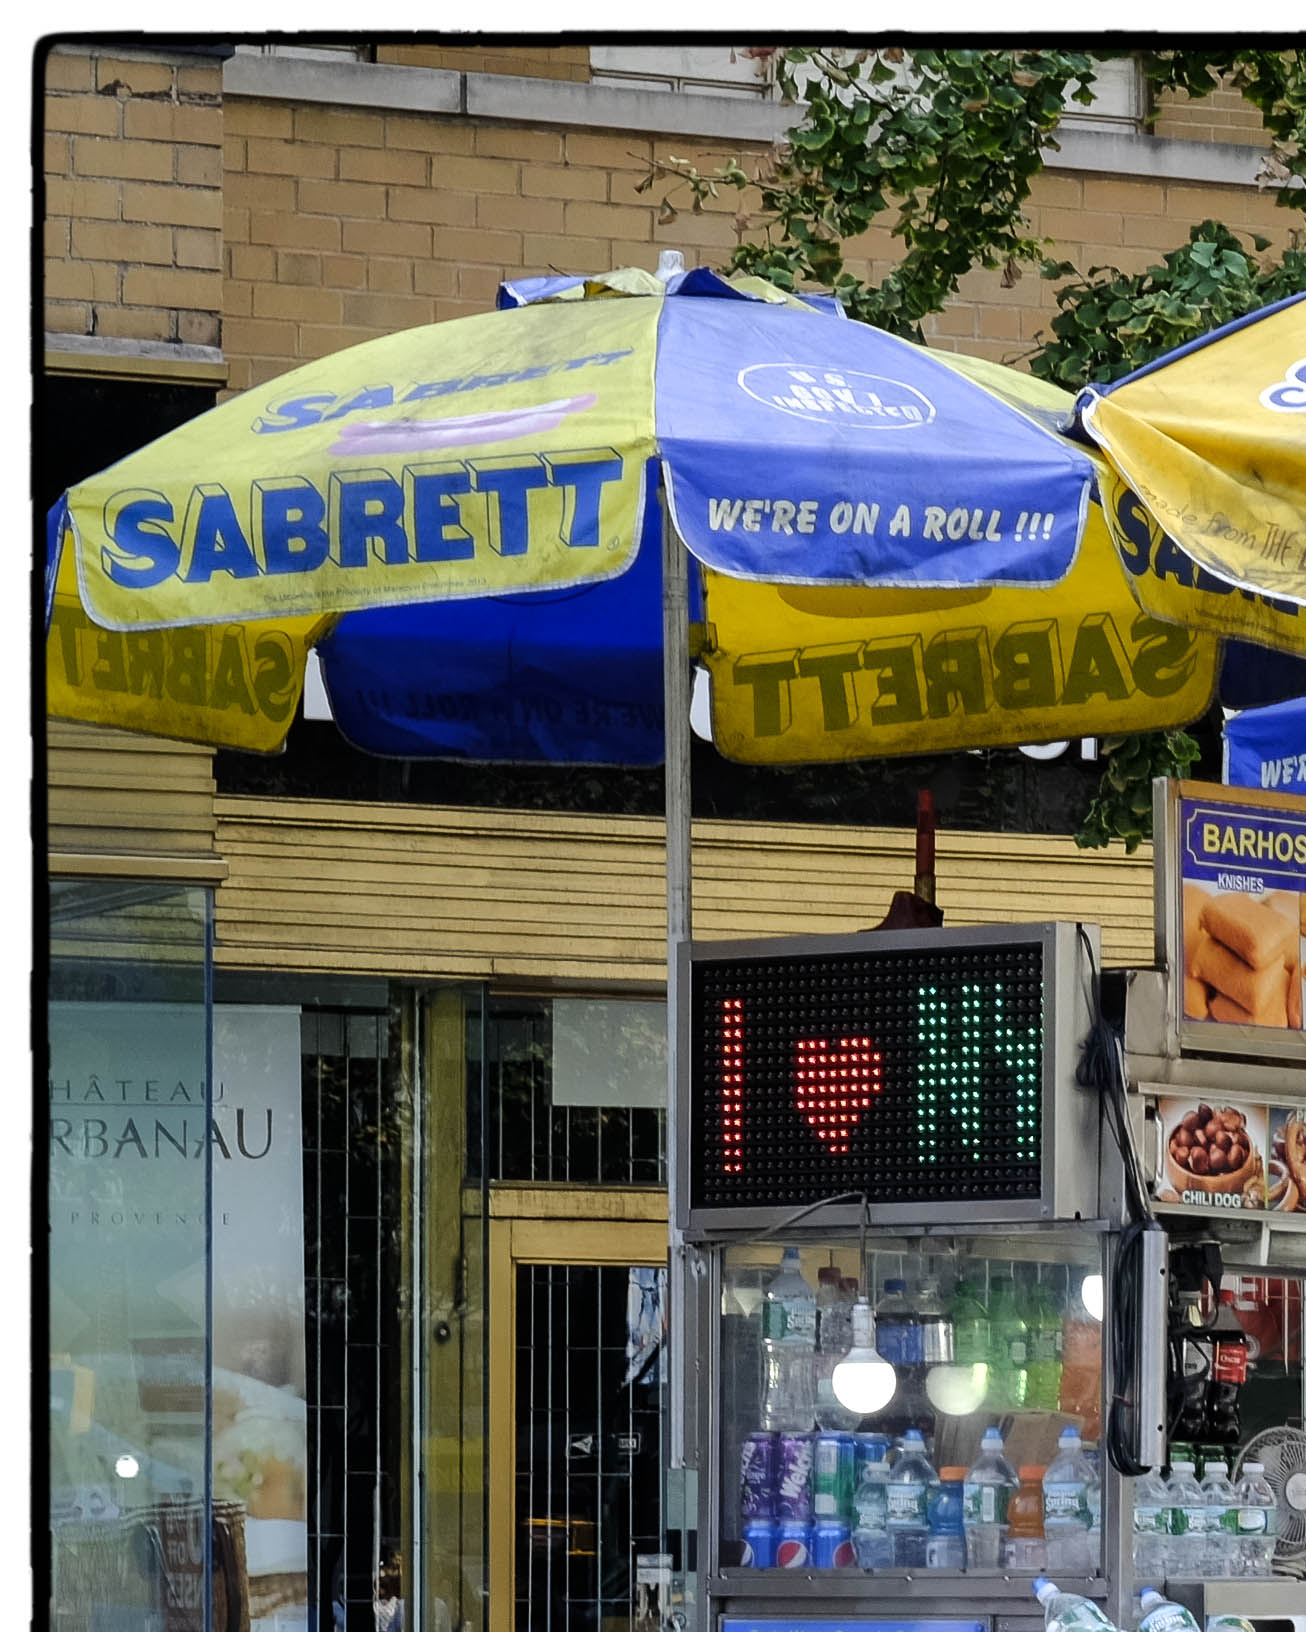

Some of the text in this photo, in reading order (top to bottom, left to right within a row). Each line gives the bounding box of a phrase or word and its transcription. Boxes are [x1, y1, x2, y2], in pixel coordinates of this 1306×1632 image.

[249, 346, 635, 434] SABRETT
[101, 447, 623, 589] SABRETT
[708, 498, 1055, 542] WE'RE ON A ROLL !!!
[1139, 484, 1198, 525] made
[1204, 512, 1257, 548] from
[1260, 521, 1298, 568] THE
[1217, 873, 1265, 893] KNISHES
[50, 1074, 225, 1102] HÂTEAU
[722, 999, 743, 1173] I
[50, 1107, 273, 1160] RBANAU
[71, 1212, 231, 1226] PROVENE
[1182, 1189, 1242, 1208] CHILI DOG
